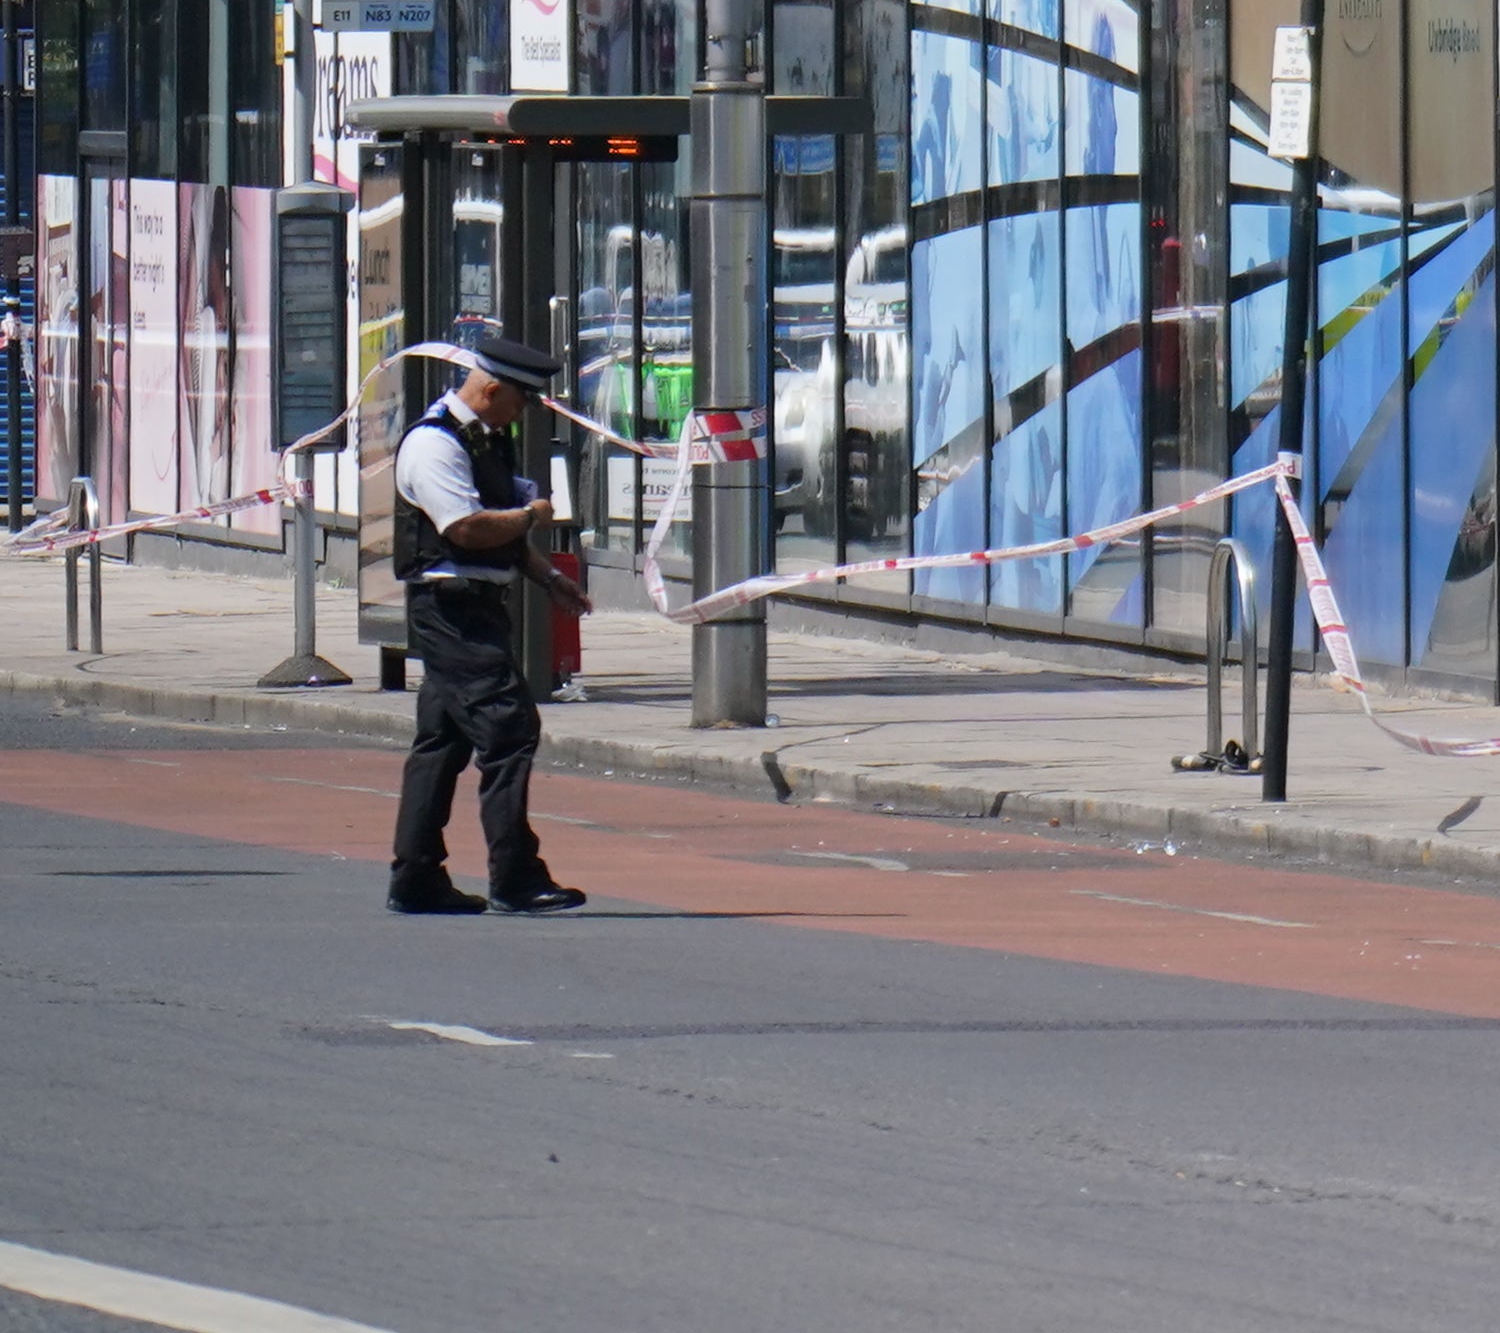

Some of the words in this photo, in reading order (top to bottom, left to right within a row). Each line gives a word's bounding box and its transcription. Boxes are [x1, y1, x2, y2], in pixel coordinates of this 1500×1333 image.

[334, 11, 350, 21] E11
[365, 10, 391, 22] N83
[400, 10, 430, 22] N207
[1427, 19, 1461, 63] Uxbridge
[318, 55, 379, 139] reams
